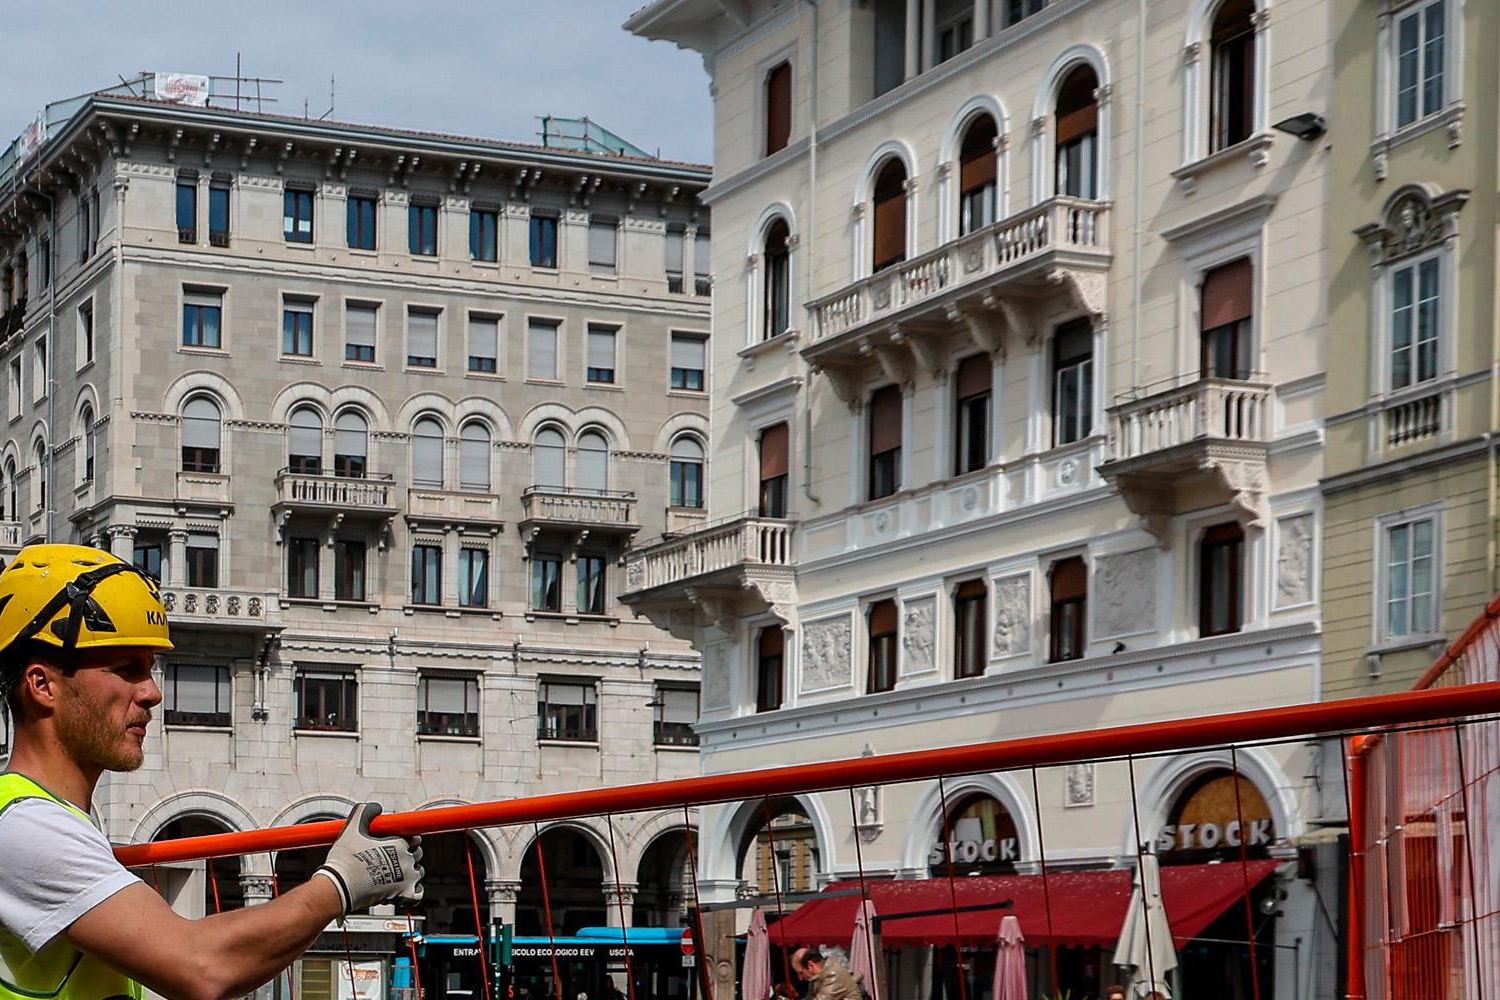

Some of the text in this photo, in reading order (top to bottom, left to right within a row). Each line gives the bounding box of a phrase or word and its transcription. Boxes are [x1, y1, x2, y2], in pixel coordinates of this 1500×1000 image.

[1158, 820, 1272, 851] STOCK
[930, 838, 1017, 865] STOCK
[453, 948, 482, 957] ENTRA
[511, 948, 595, 957] EICOLO ECOOGICO EEV
[508, 985, 514, 998] 5
